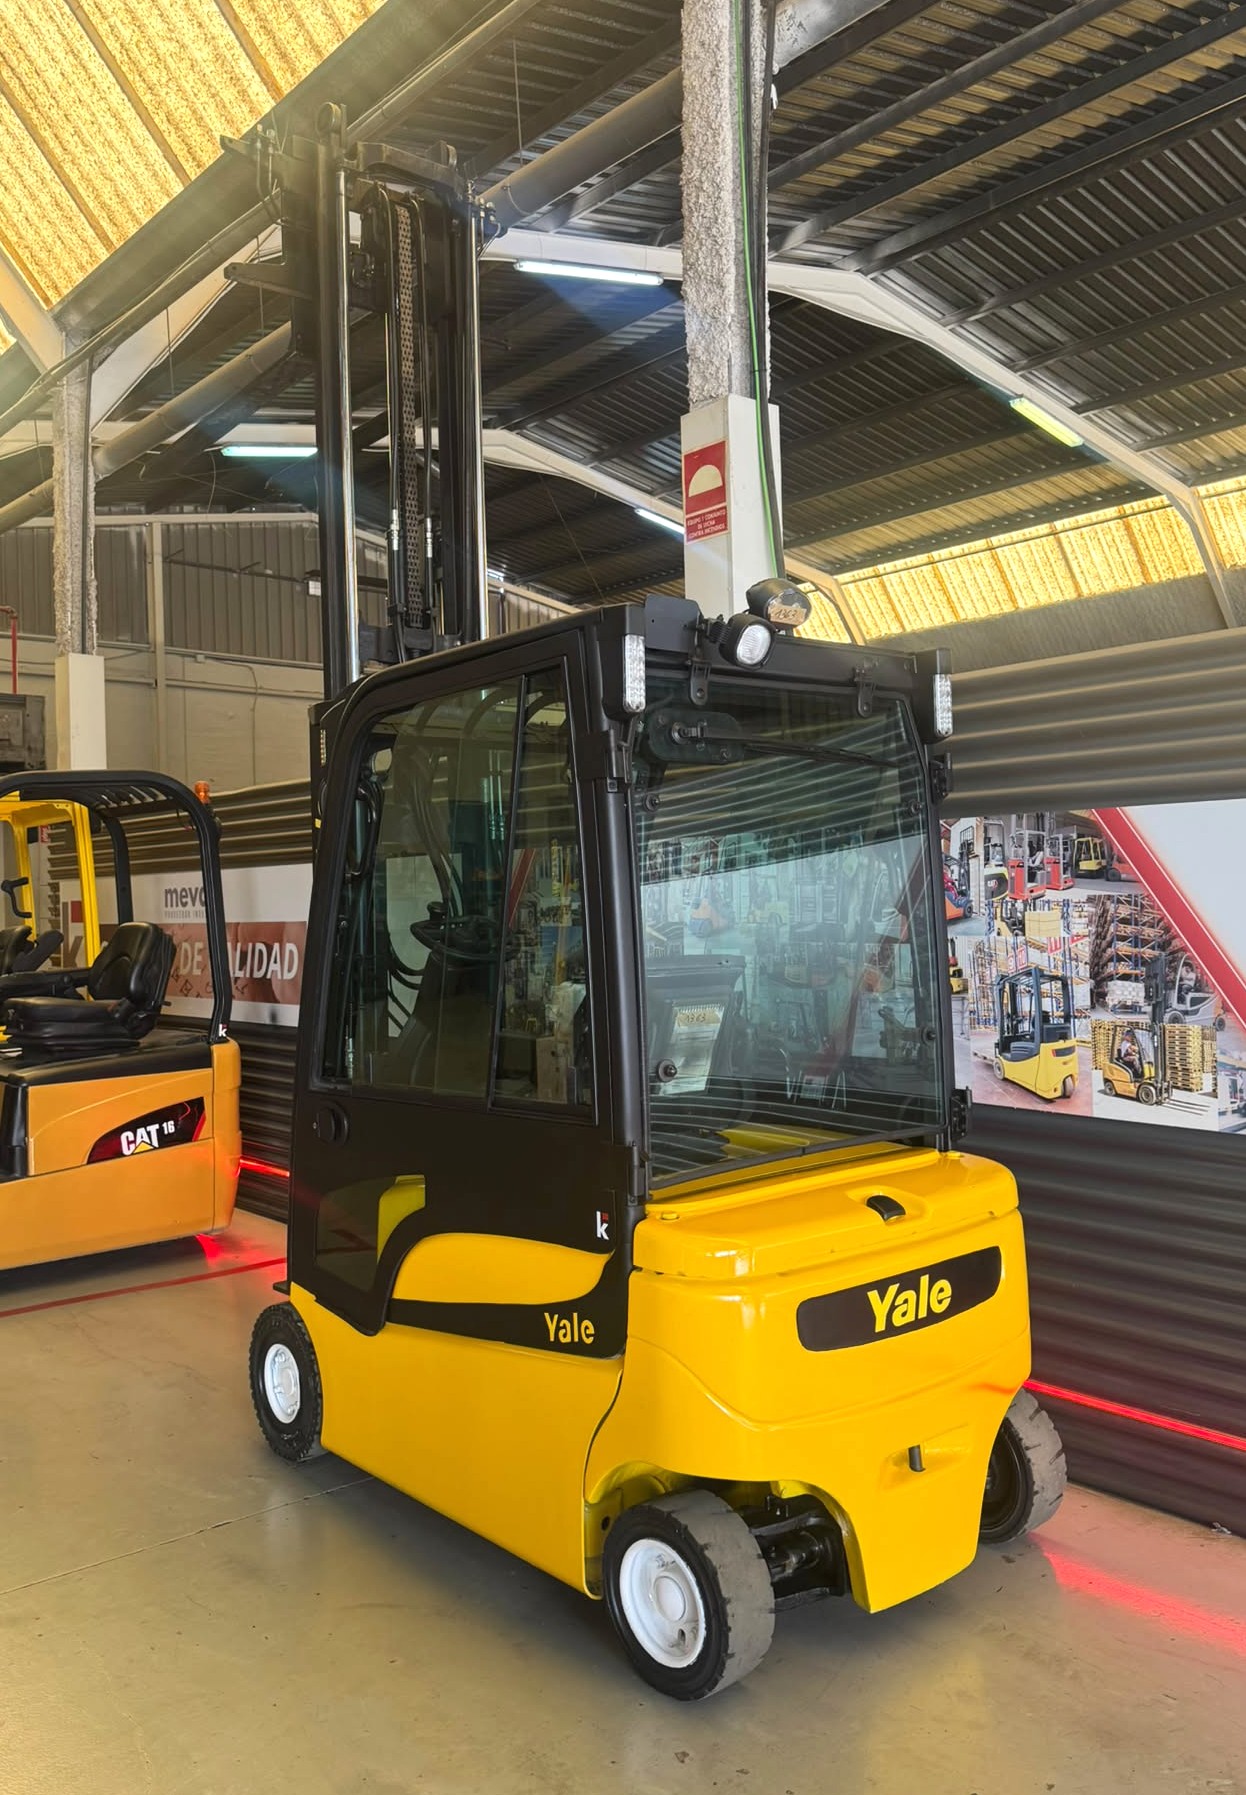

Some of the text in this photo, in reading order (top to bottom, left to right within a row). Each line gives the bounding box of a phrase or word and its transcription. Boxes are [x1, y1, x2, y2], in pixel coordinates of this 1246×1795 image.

[179, 941, 204, 975] DE
[120, 1120, 175, 1156] CAT 16
[867, 1273, 952, 1333] Yale
[543, 1312, 595, 1345] Yale
